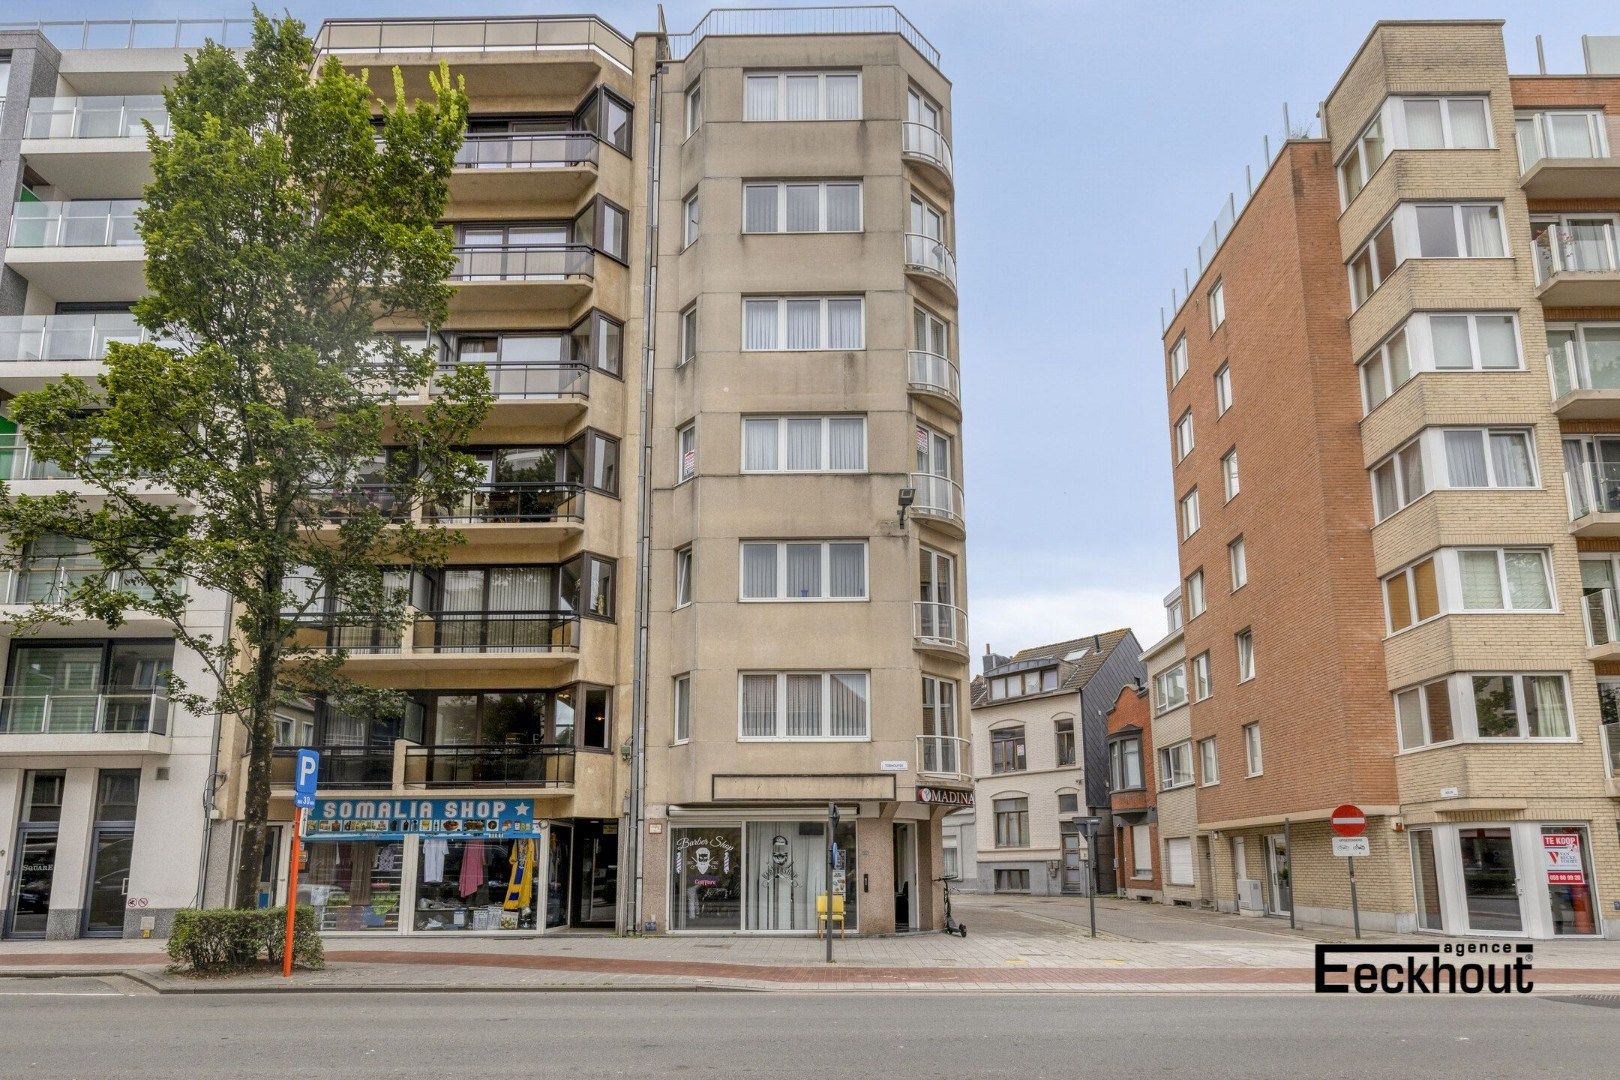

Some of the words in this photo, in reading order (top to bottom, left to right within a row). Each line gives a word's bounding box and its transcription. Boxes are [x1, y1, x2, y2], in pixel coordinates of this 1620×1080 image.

[300, 756, 316, 786] P
[931, 789, 975, 804] MADINA
[323, 801, 433, 818] SOMALIA
[444, 801, 506, 818] SHOP
[676, 836, 709, 851] Barber
[709, 835, 735, 852] Shop
[1544, 837, 1555, 845] TE
[1555, 837, 1576, 845] KOOP
